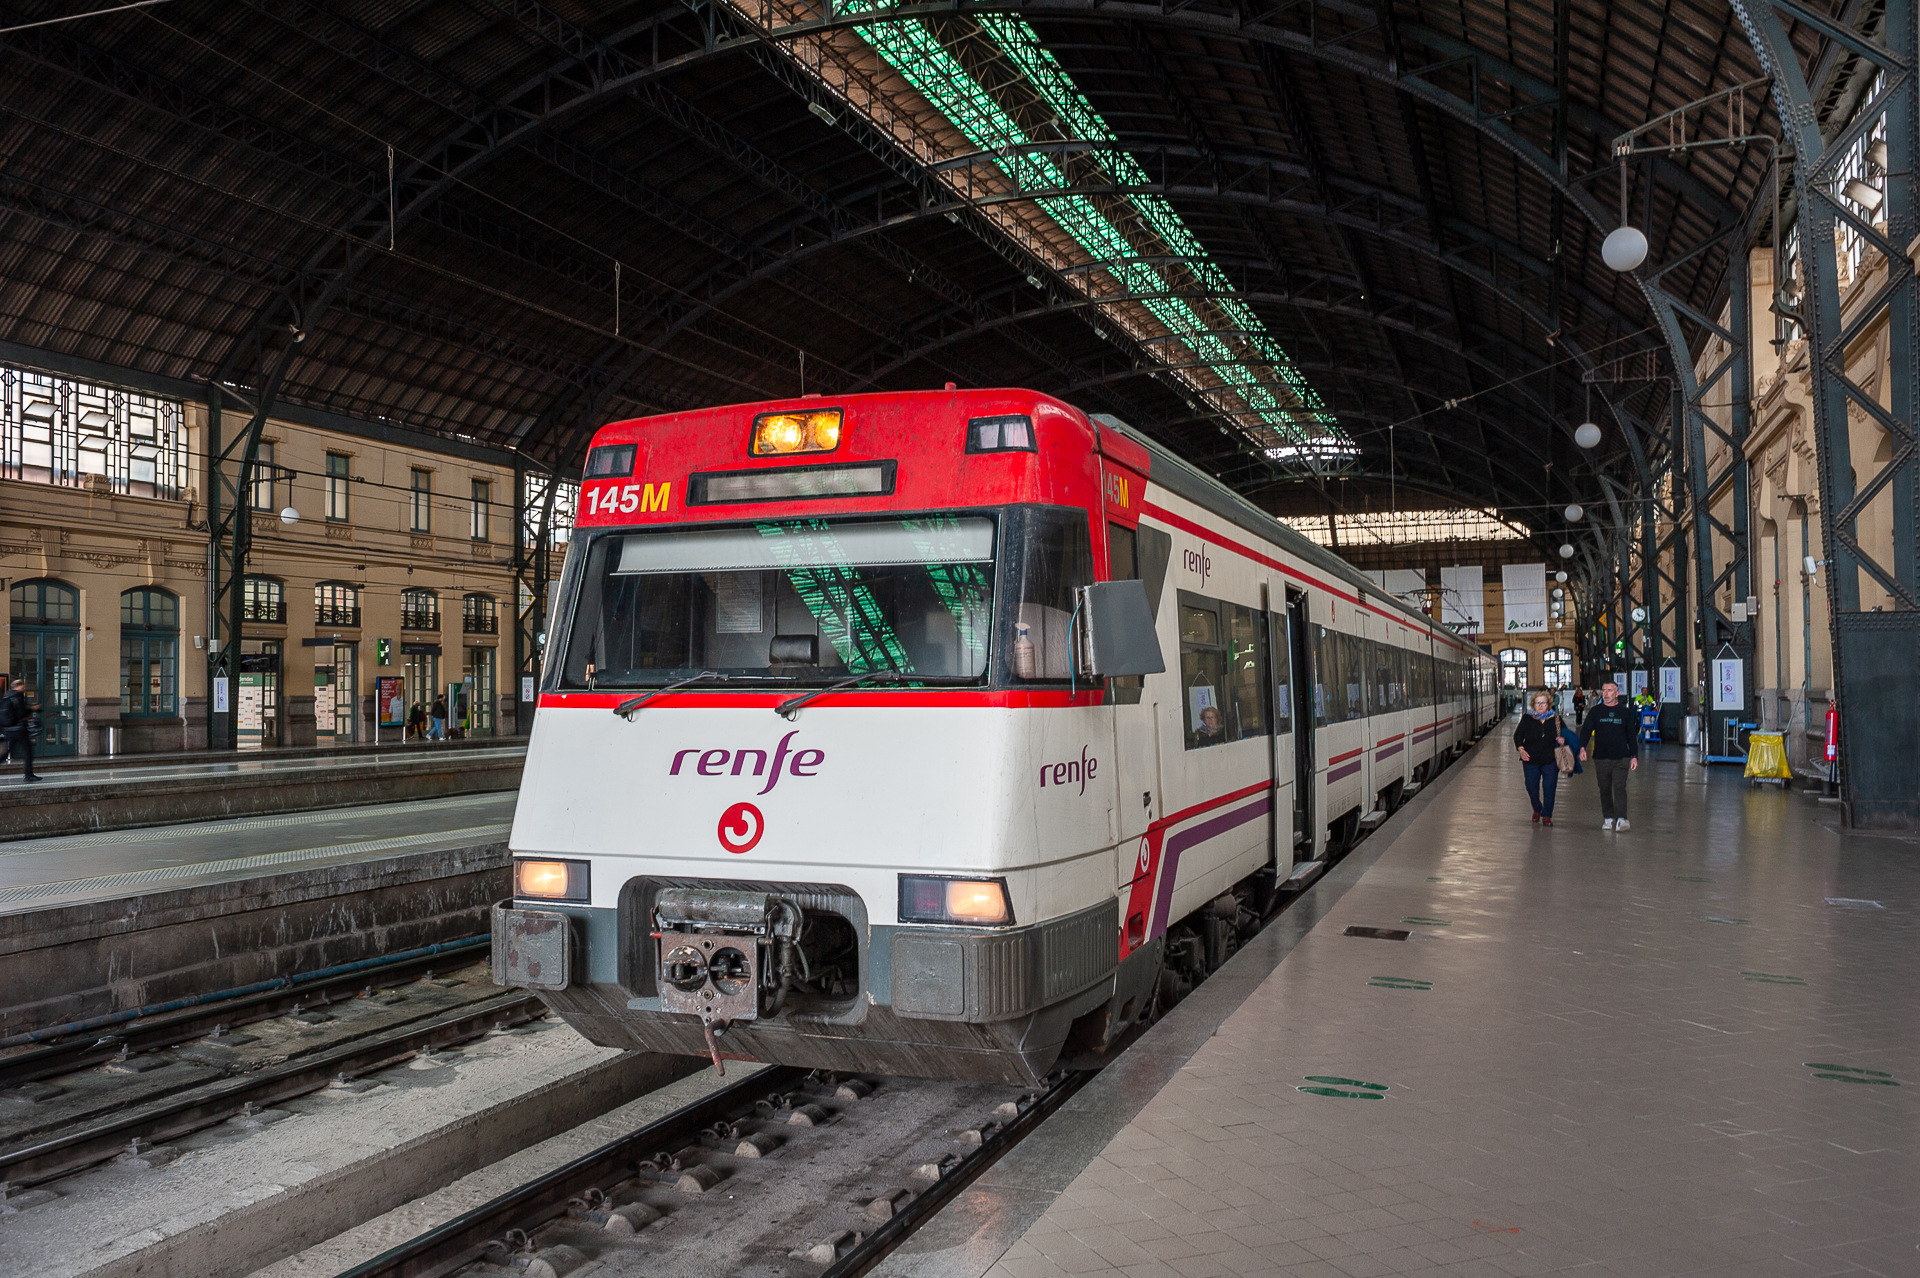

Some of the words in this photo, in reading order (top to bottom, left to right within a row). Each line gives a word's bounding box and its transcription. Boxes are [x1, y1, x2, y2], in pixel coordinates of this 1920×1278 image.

[587, 482, 671, 515] 145M
[1103, 469, 1129, 509] 145M
[1183, 543, 1211, 590] renfe
[1520, 619, 1544, 628] adif
[669, 730, 825, 796] renfe
[1040, 745, 1098, 797] renfe
